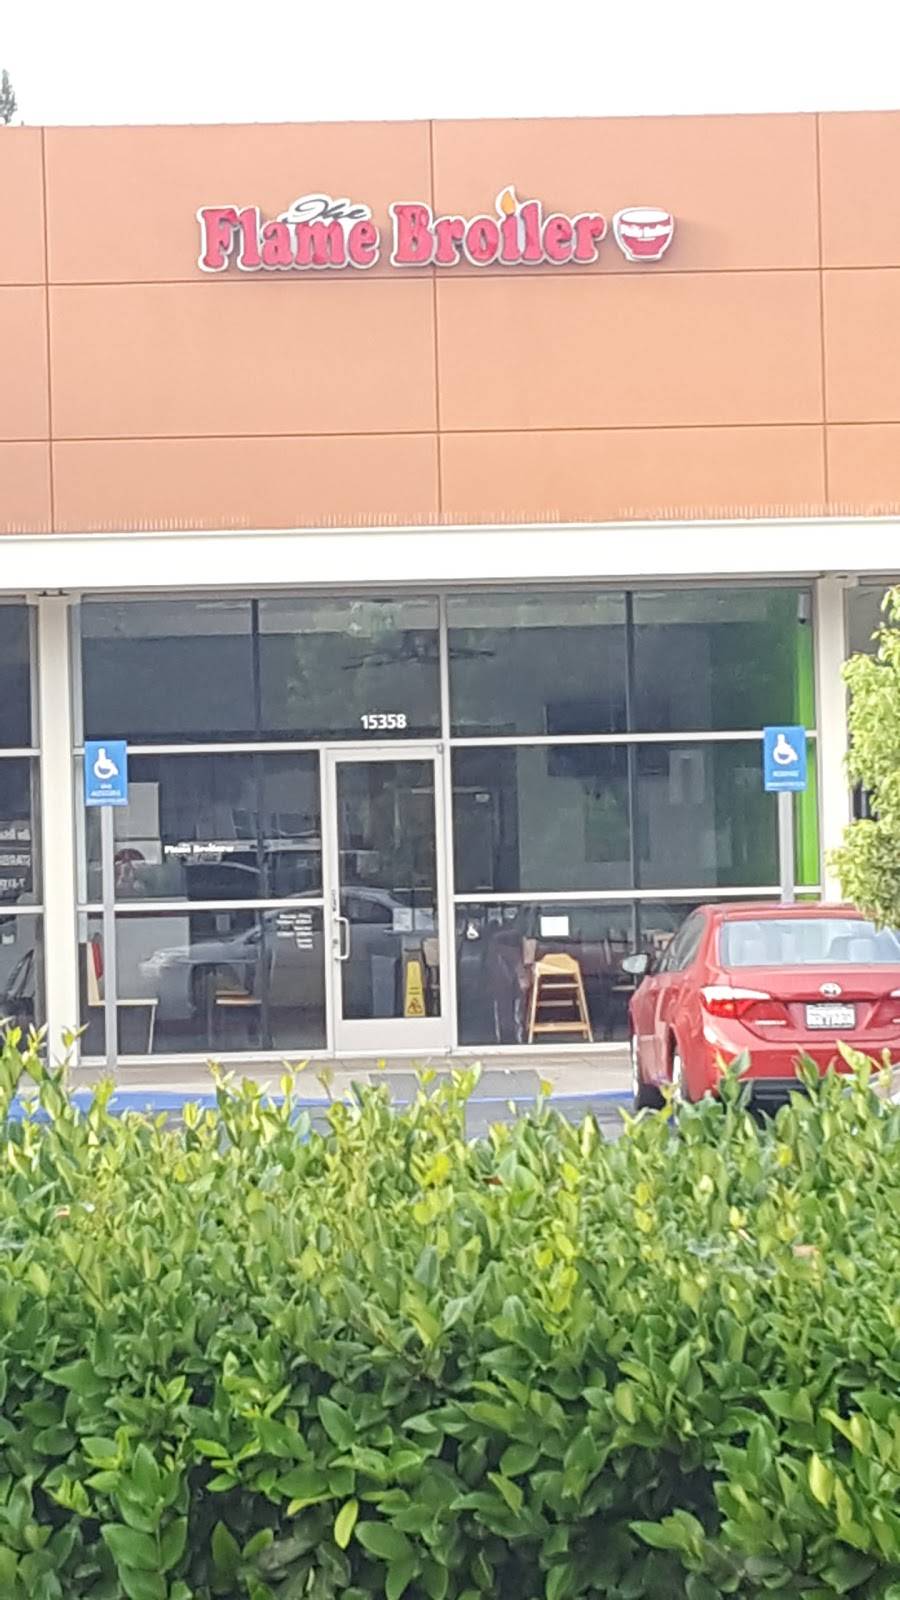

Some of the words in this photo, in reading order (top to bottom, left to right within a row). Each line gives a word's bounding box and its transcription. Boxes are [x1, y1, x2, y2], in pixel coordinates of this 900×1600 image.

[281, 197, 368, 225] The
[200, 206, 378, 269] Flame
[392, 200, 606, 264] Broiler
[360, 713, 407, 730] 15358
